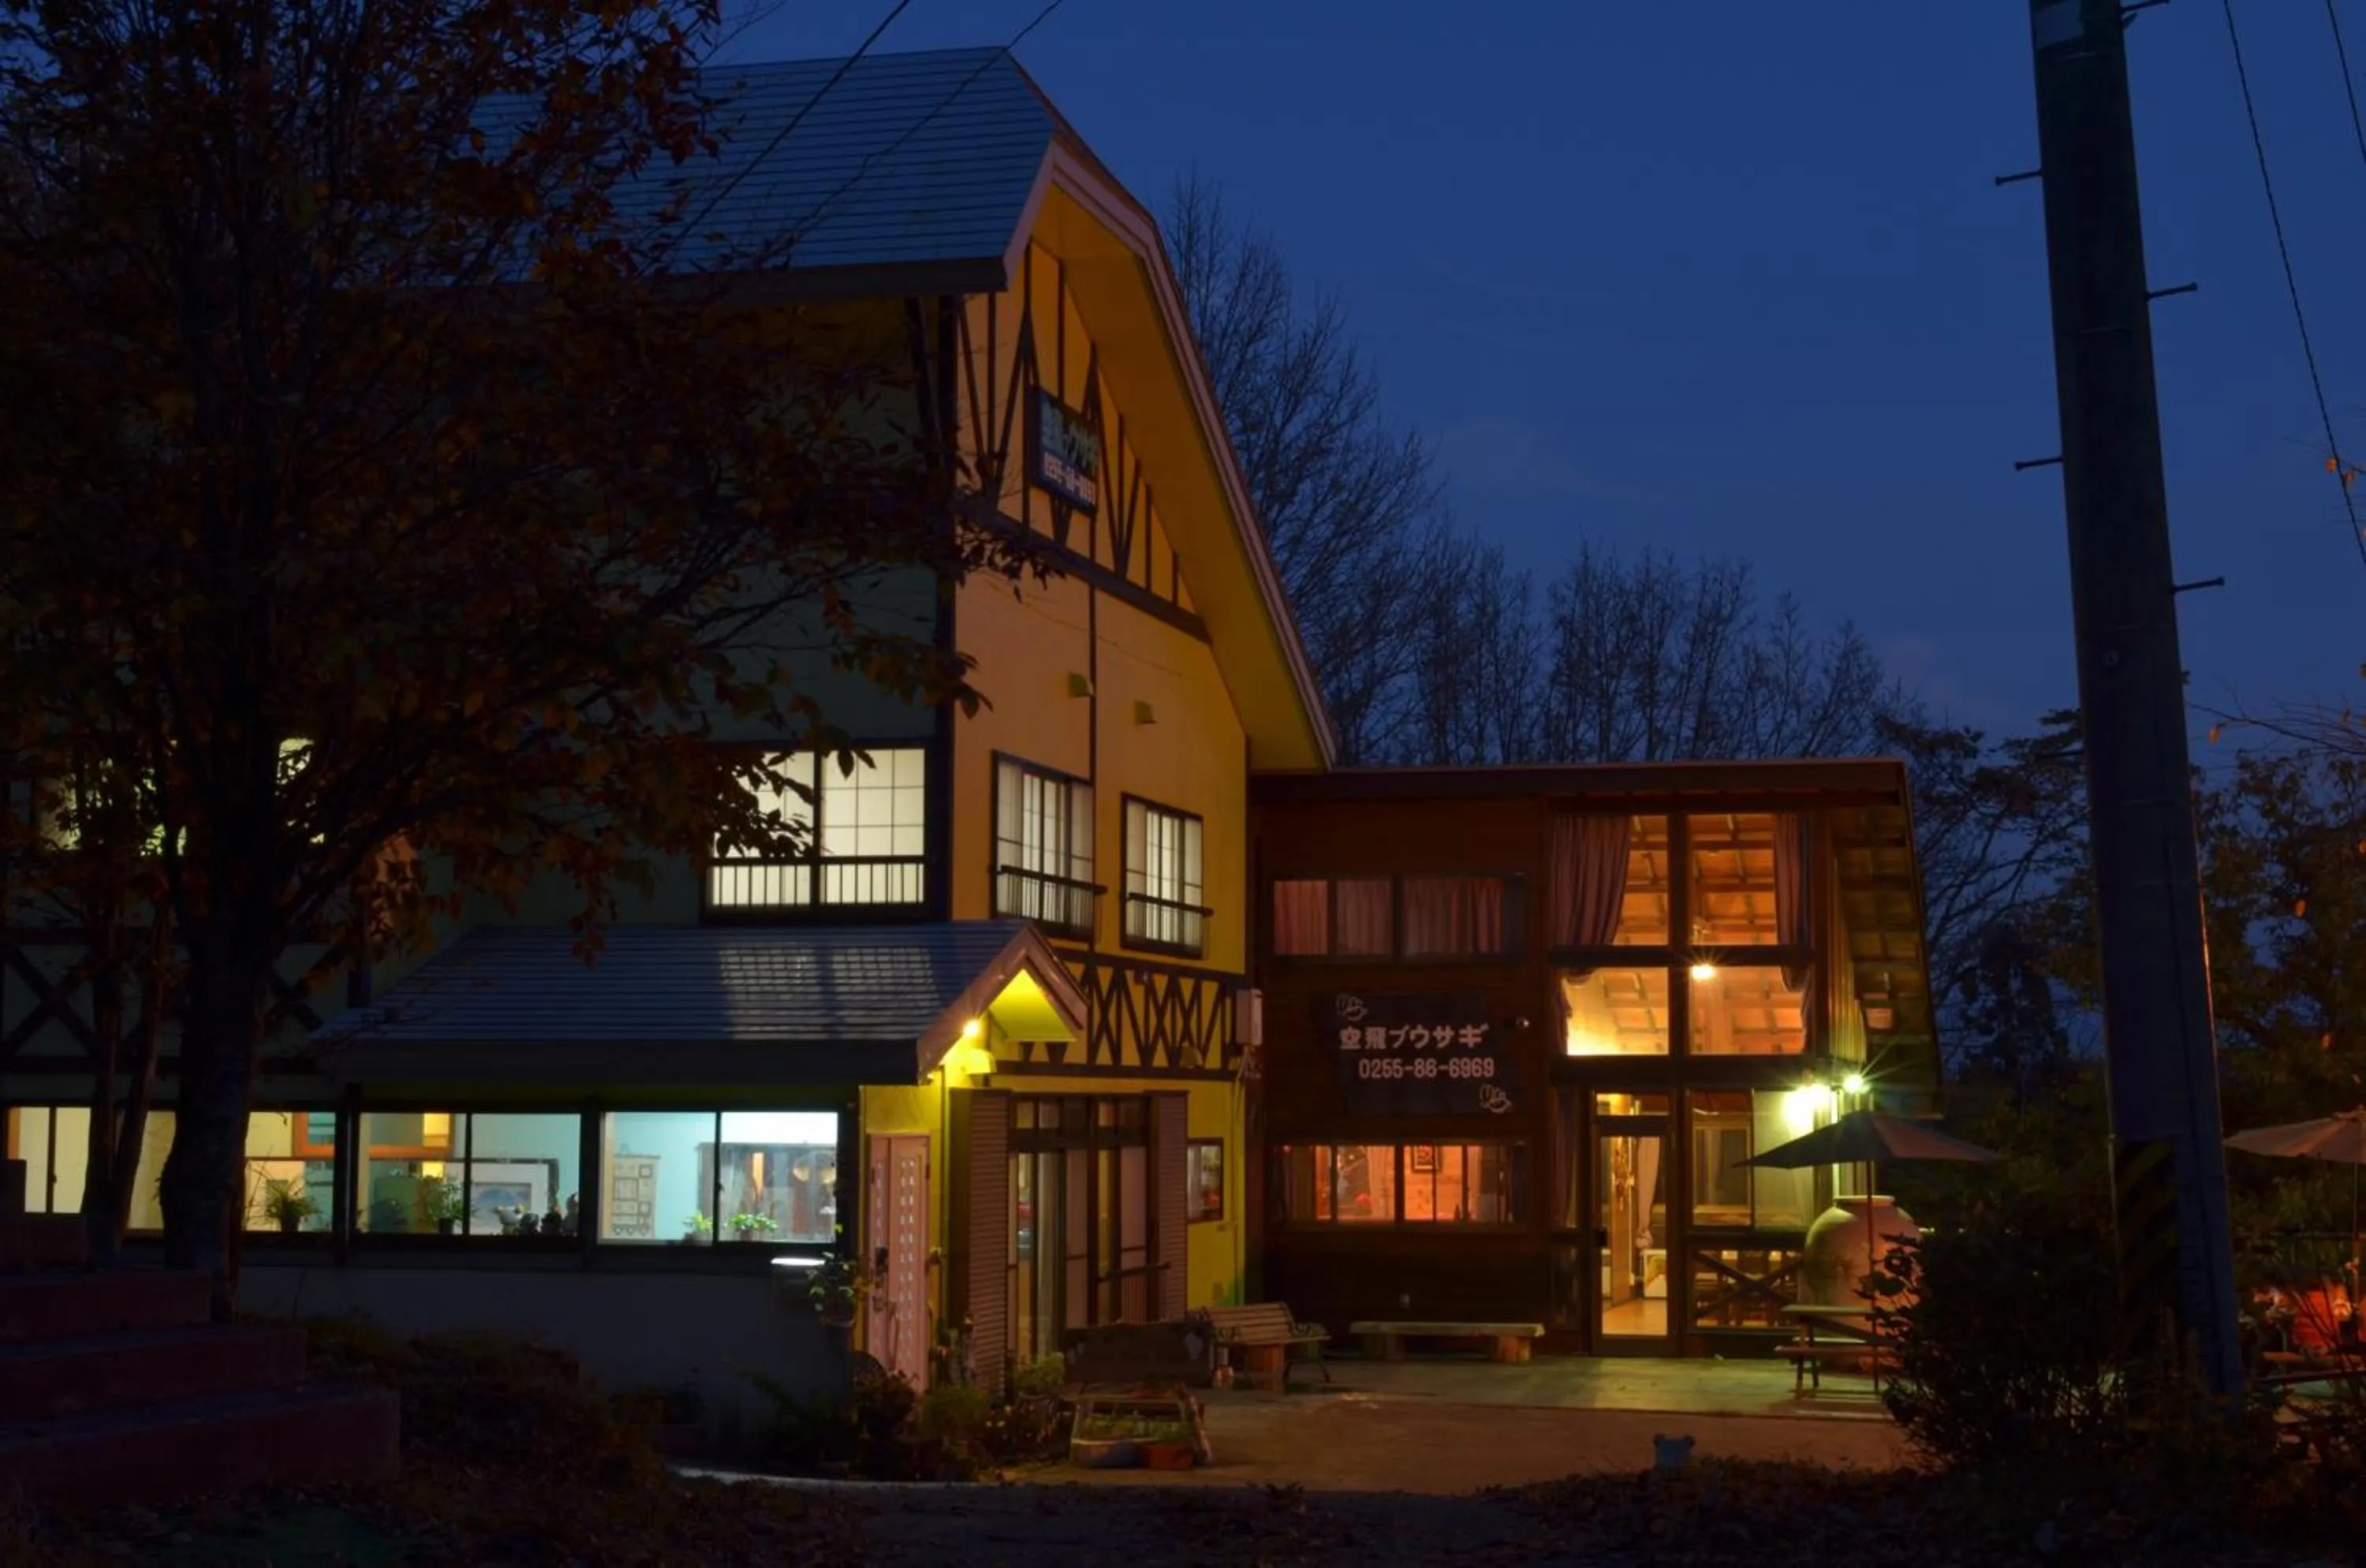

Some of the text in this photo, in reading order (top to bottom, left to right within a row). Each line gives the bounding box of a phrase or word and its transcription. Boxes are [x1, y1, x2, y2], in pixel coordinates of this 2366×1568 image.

[1339, 1022, 1489, 1050] 空飛ブウサギ
